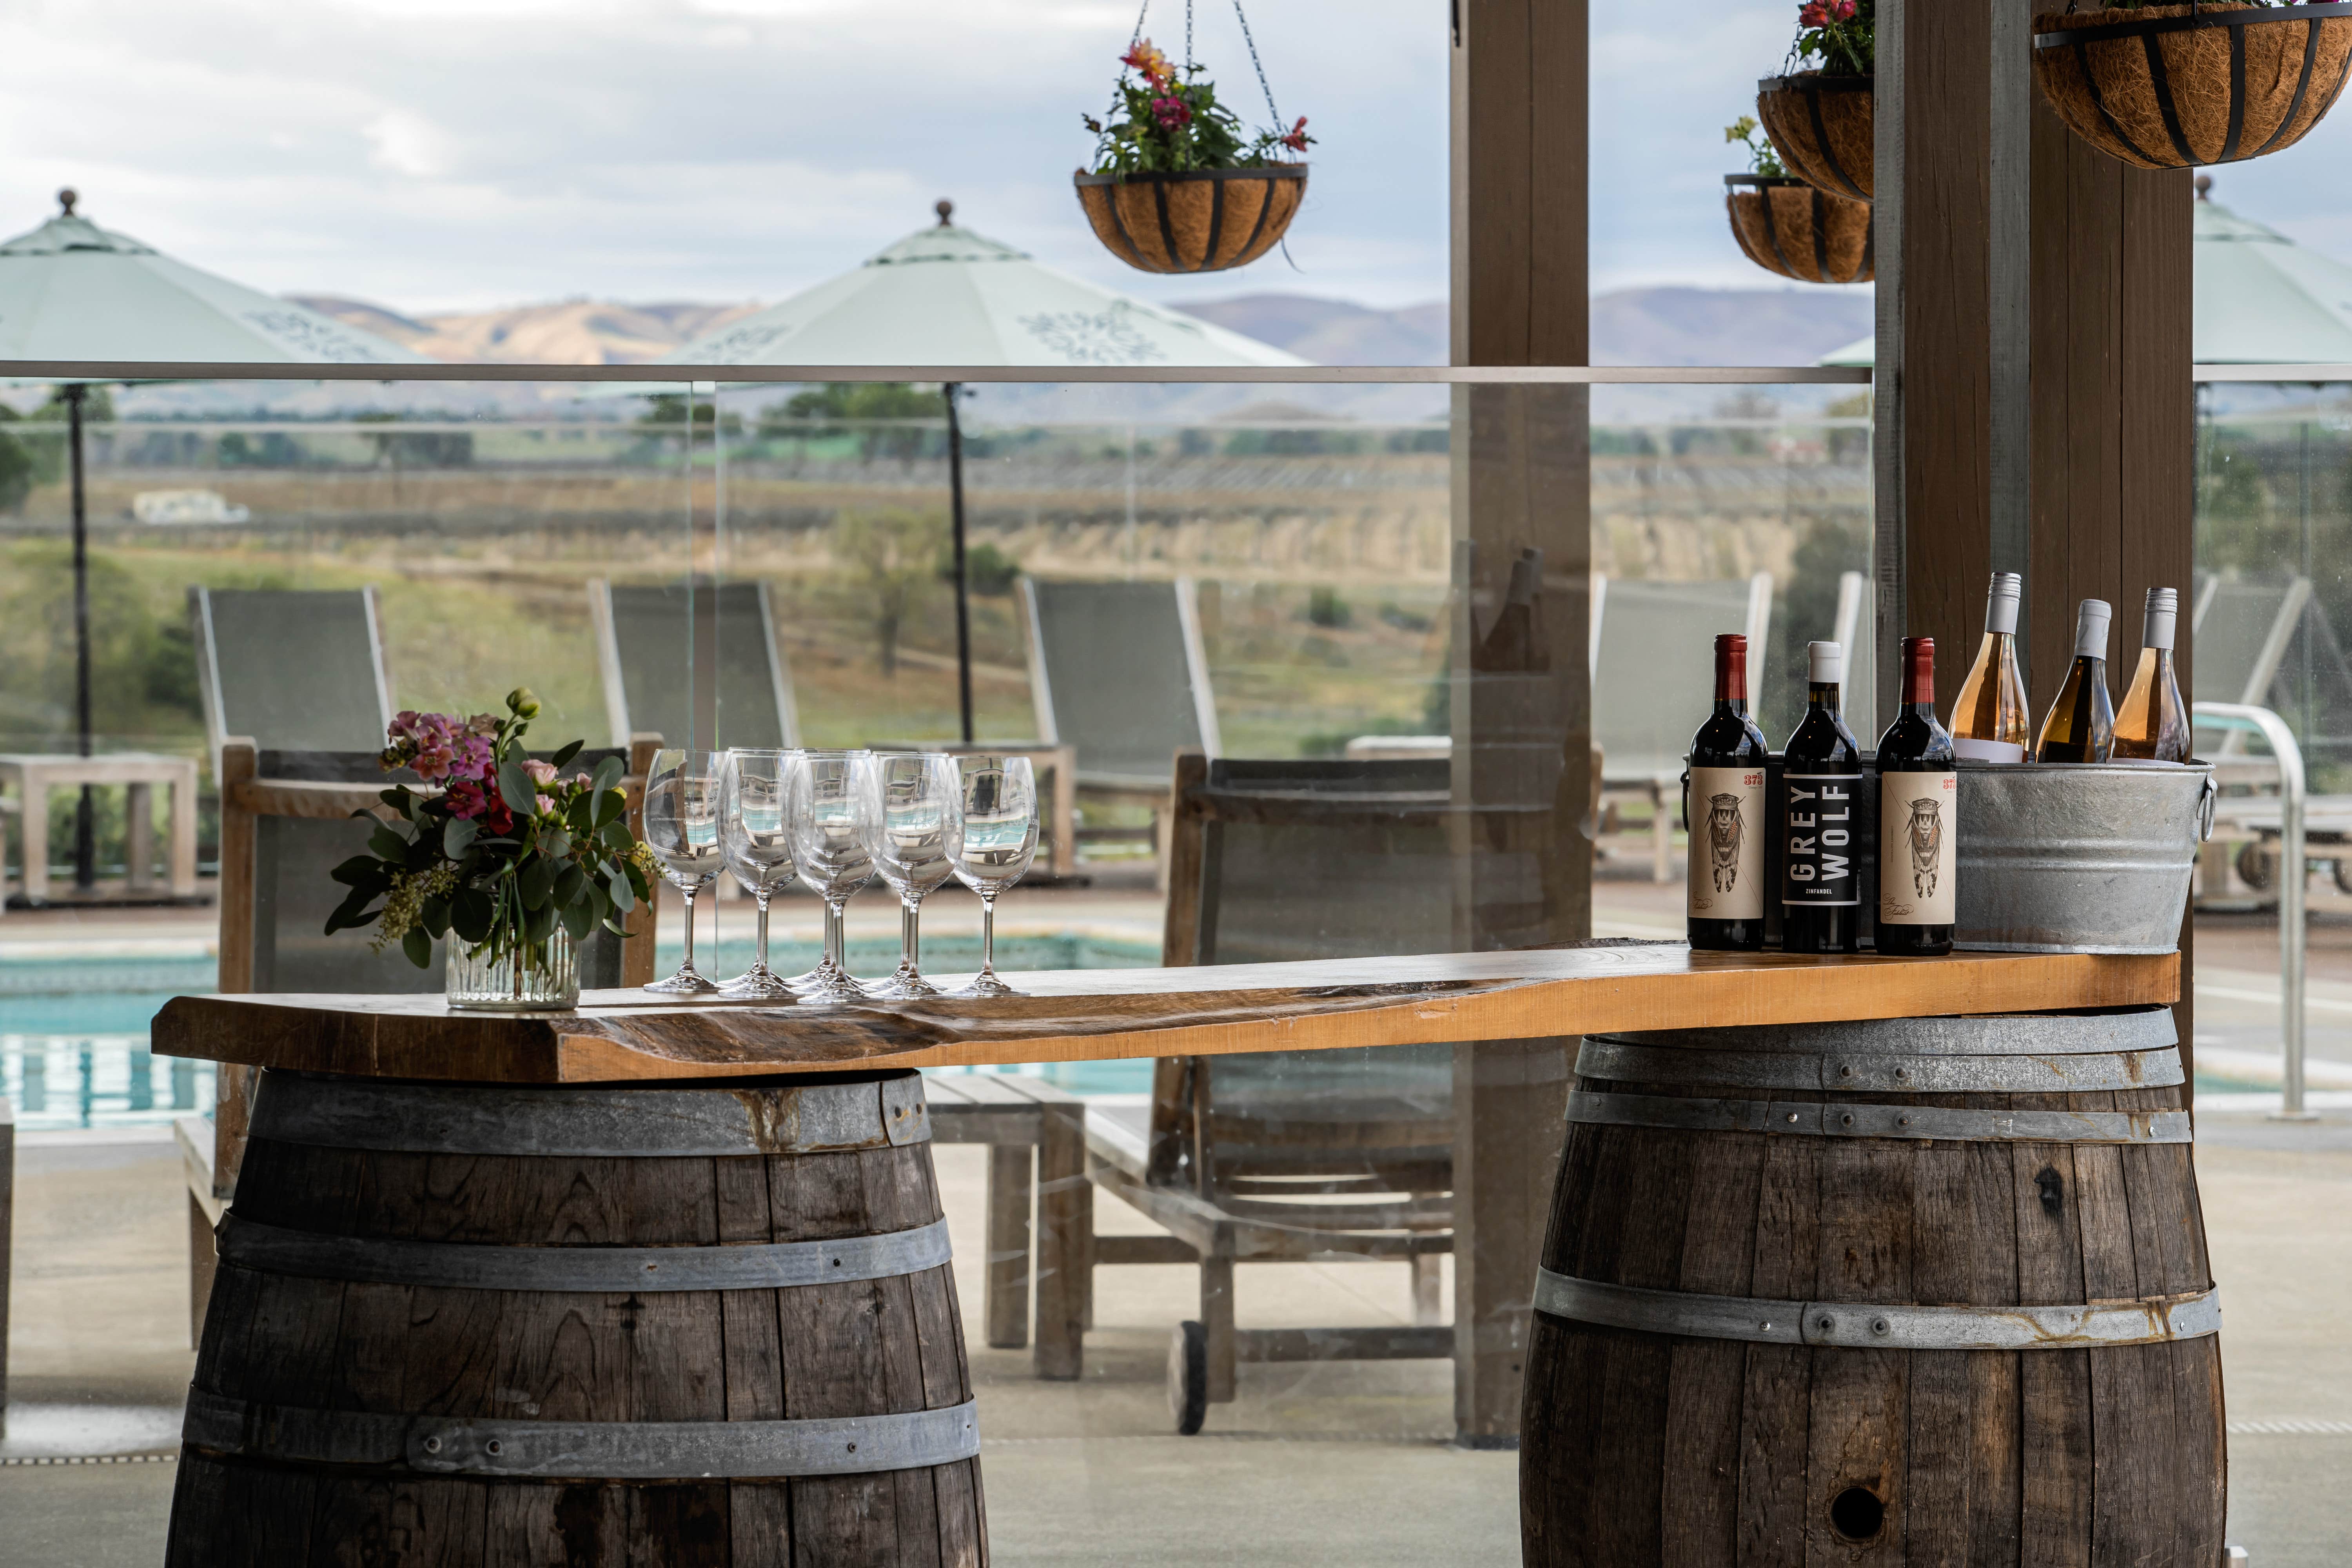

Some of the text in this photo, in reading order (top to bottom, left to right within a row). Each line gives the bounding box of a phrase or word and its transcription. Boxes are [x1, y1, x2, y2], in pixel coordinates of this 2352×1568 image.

[1744, 774, 1763, 785] 373
[1943, 779, 1956, 789] 373
[1790, 786, 1815, 881] GREY
[1822, 786, 1849, 881] WOLF
